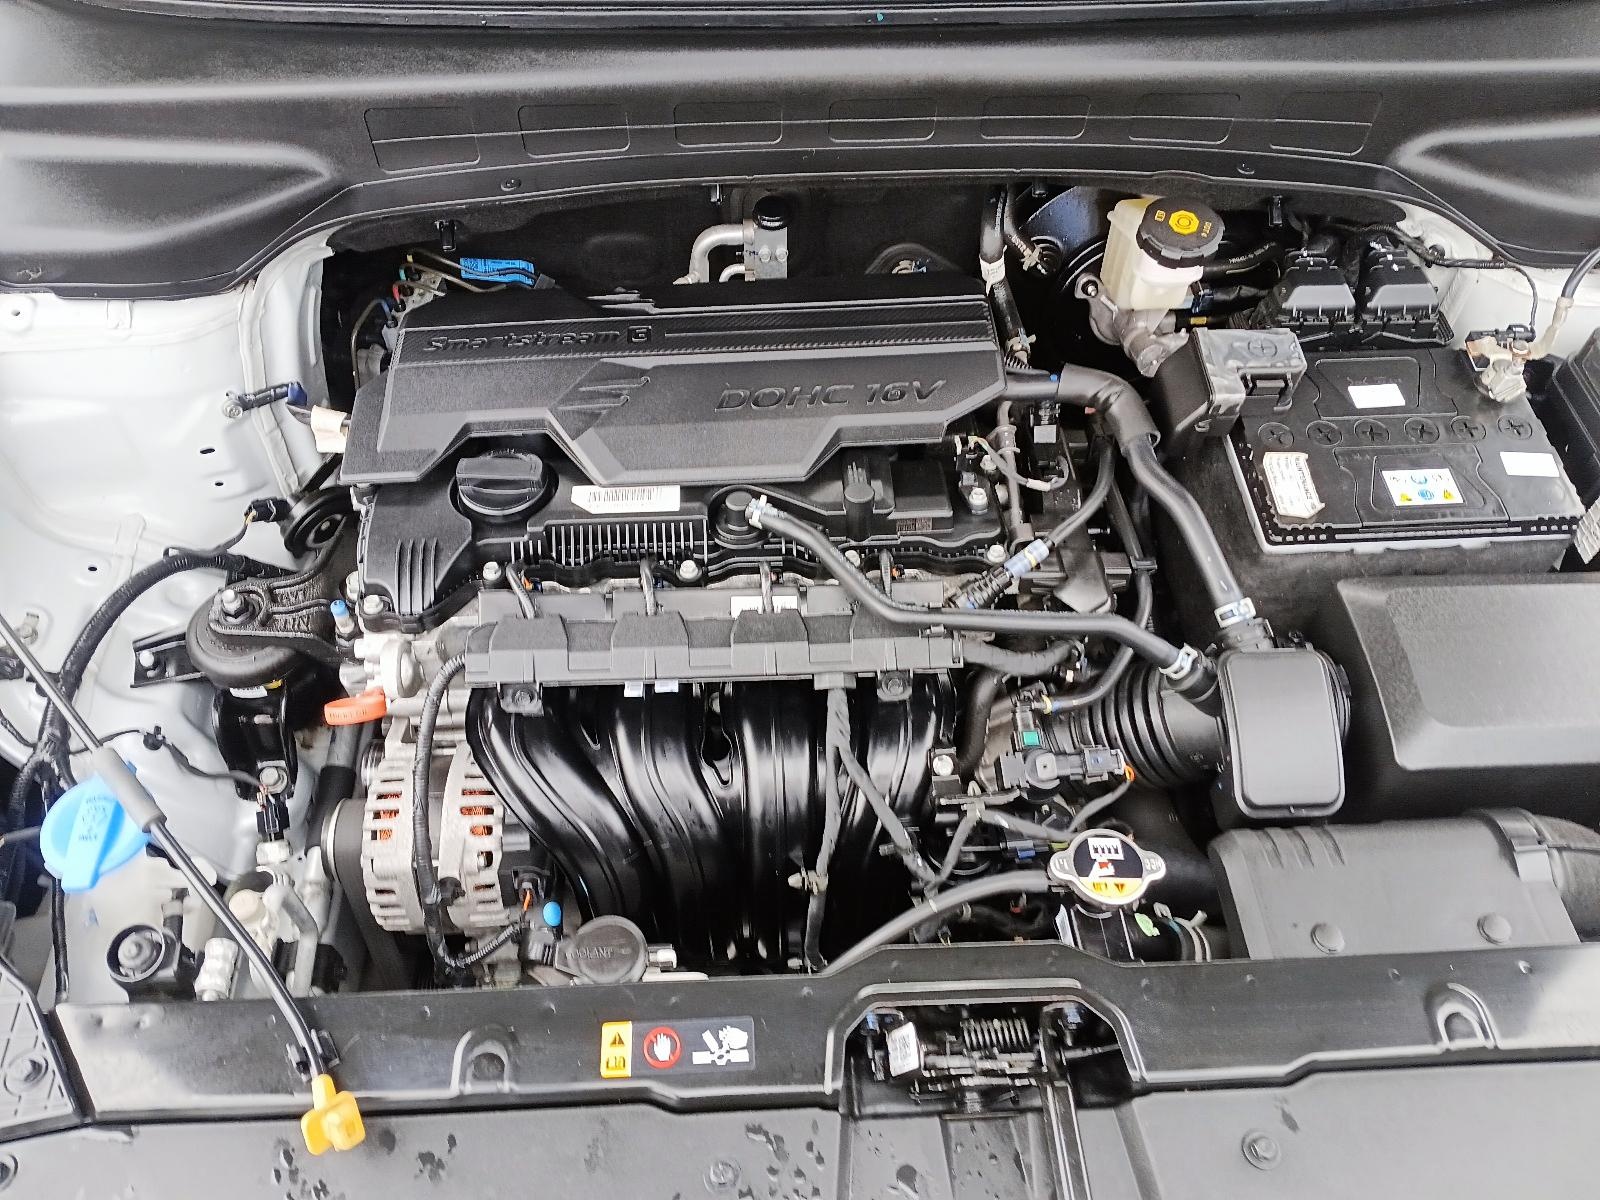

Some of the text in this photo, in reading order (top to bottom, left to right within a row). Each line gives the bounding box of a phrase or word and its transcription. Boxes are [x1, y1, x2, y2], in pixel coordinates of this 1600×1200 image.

[423, 331, 620, 352] Smartstream
[714, 378, 947, 412] DOHC 16V
